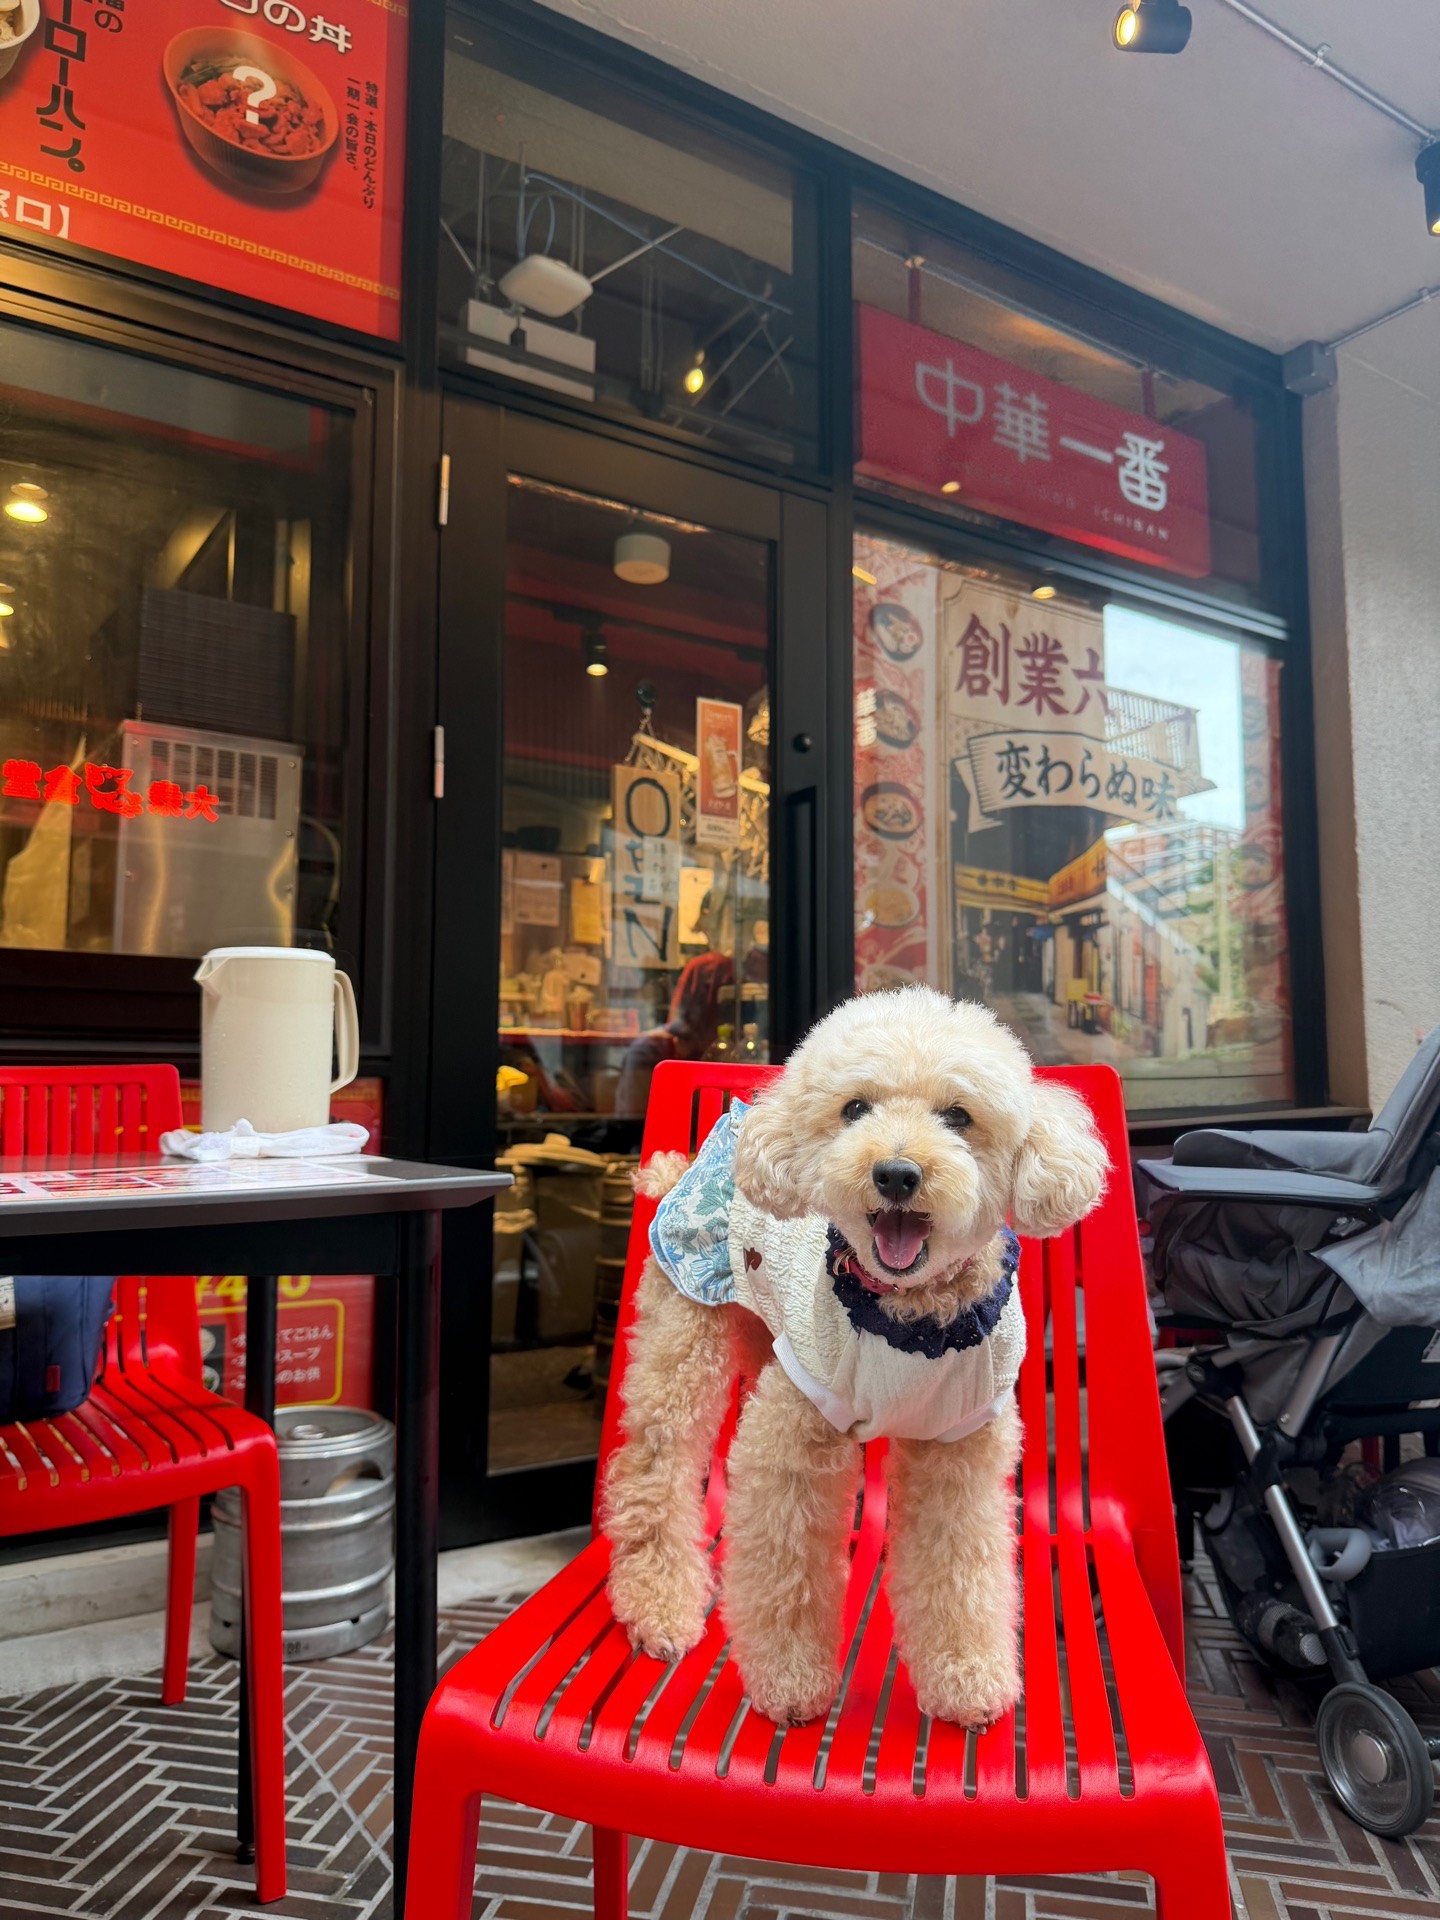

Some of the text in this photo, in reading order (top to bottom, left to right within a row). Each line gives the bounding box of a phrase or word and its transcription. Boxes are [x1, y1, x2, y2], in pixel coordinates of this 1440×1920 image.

[915, 359, 1171, 512] 中華一番
[996, 740, 1178, 823] 変わらぬ味
